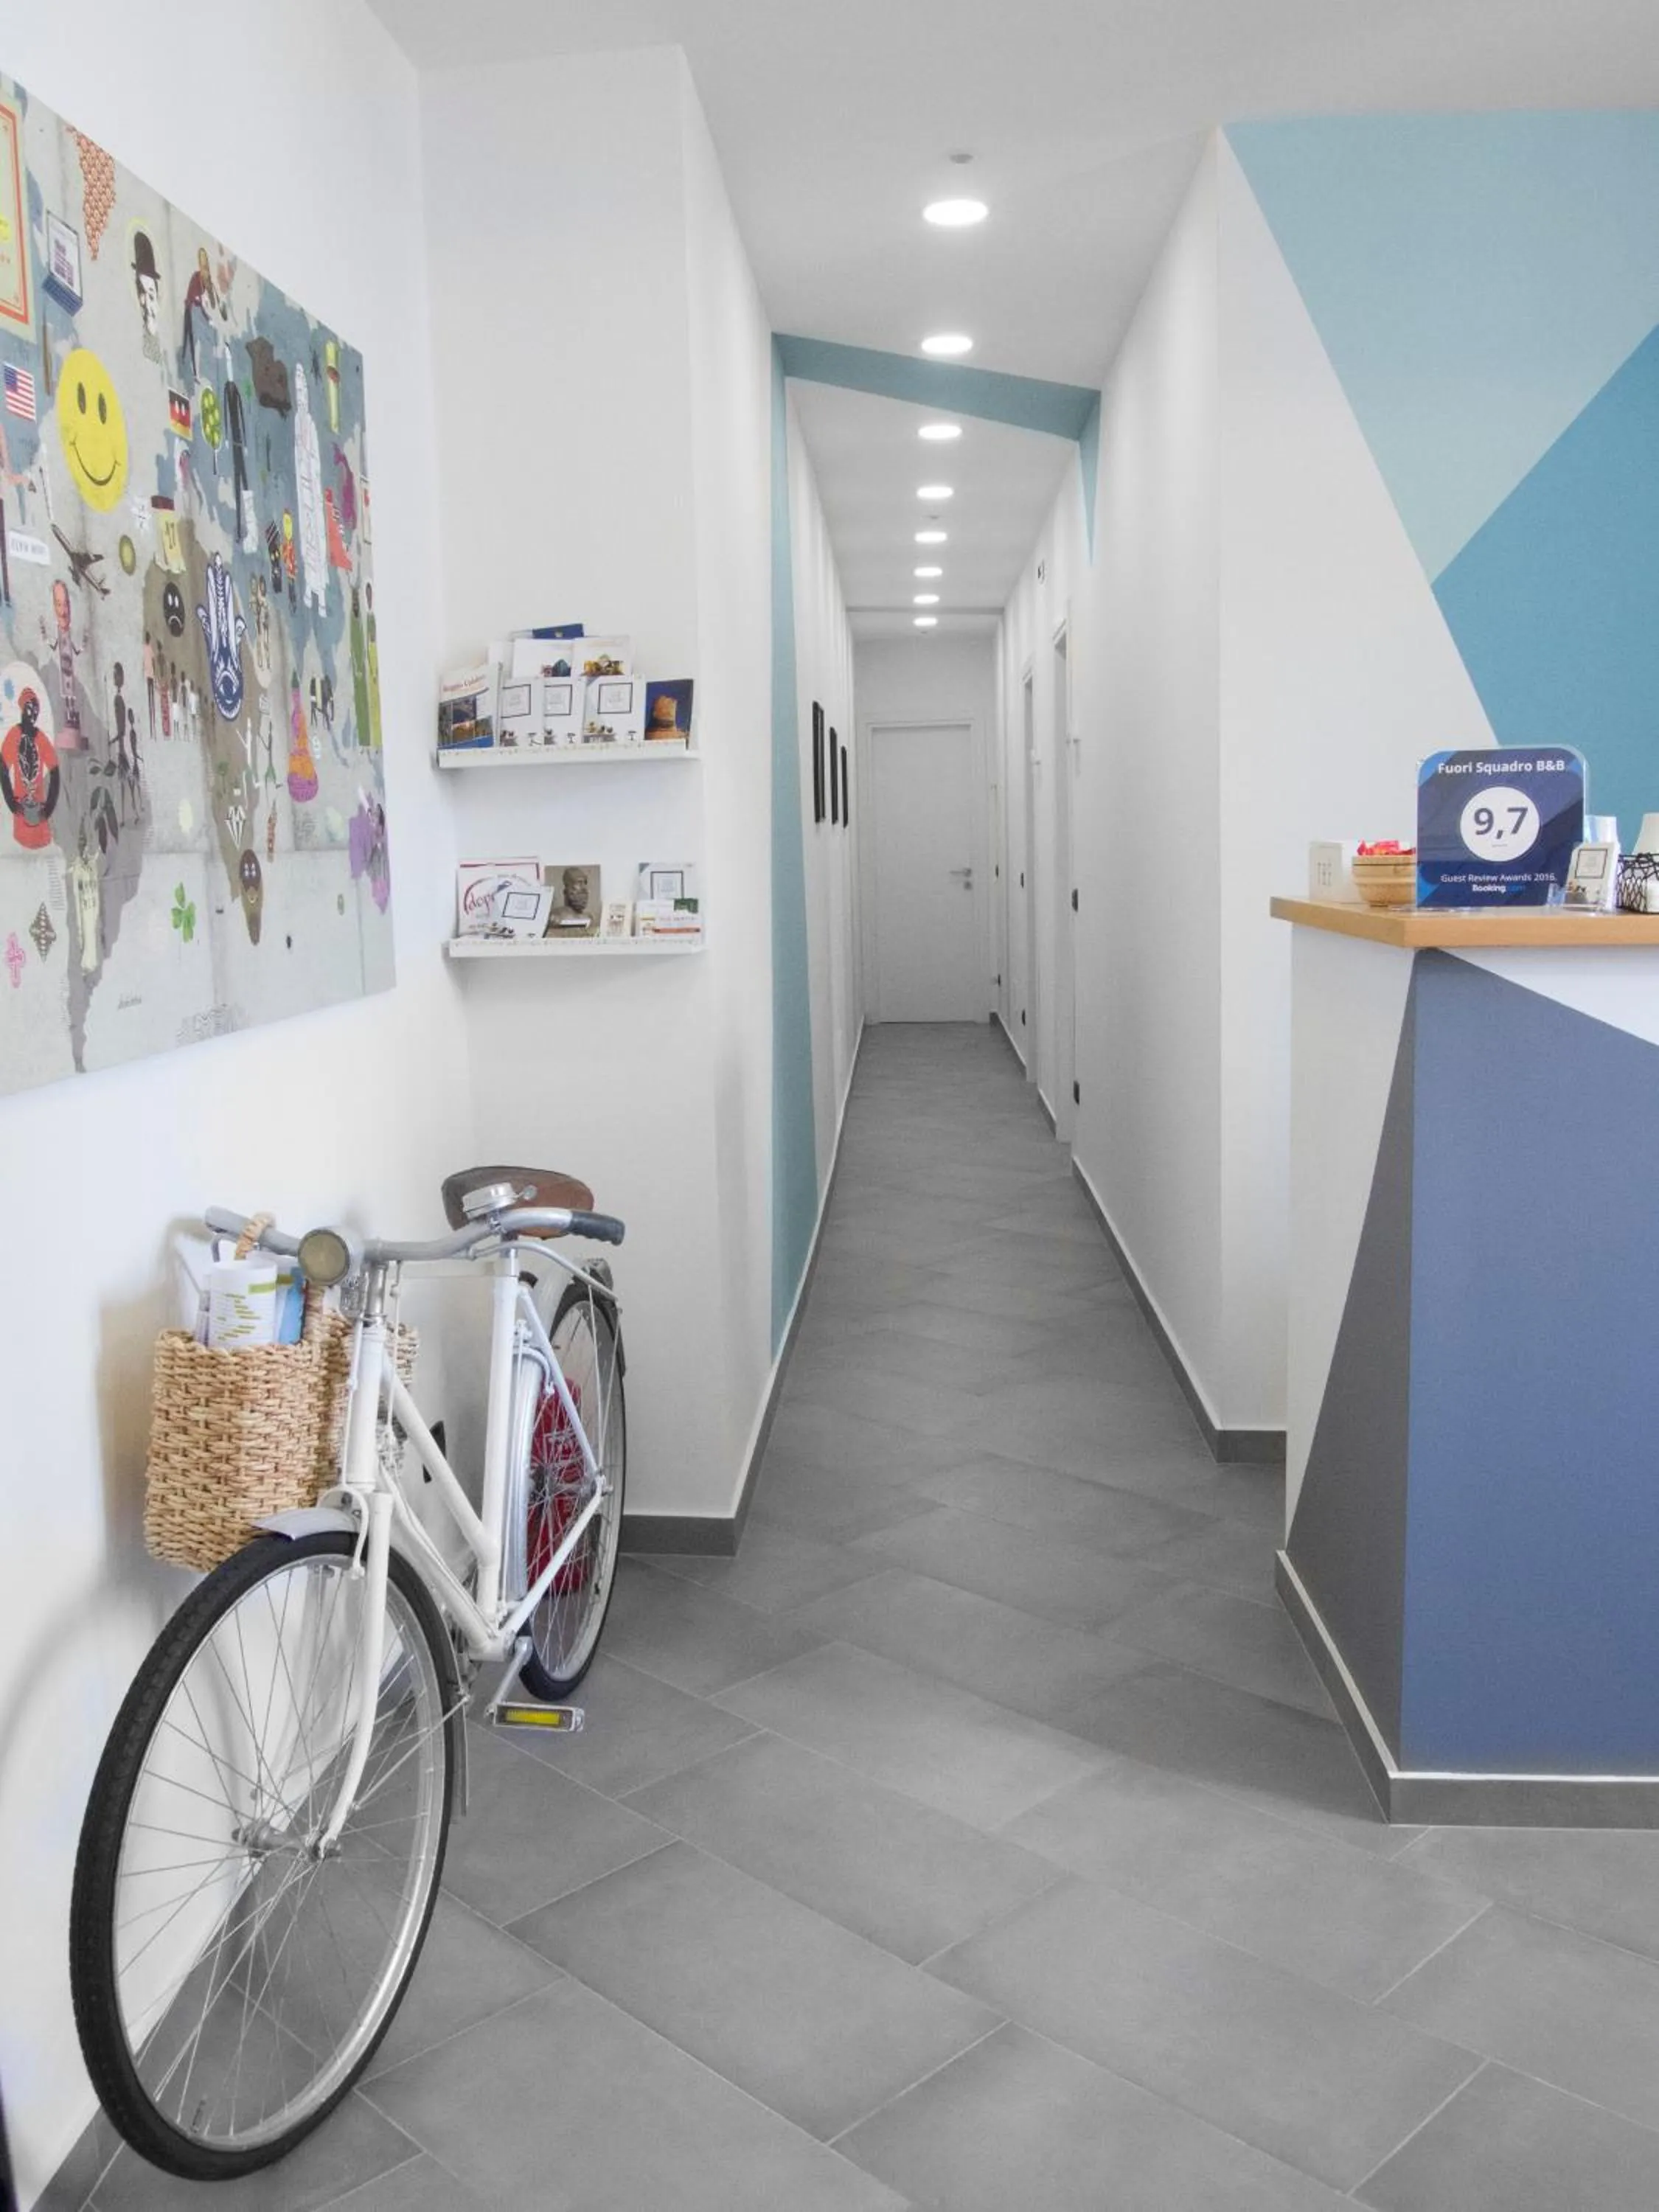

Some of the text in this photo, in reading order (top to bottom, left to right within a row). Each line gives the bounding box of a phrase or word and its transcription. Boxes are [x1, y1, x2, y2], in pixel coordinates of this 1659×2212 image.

[1439, 760, 1565, 775] Fuori Squadro B&B
[1473, 807, 1528, 840] 9,7
[1440, 874, 1467, 883] Guest
[1468, 874, 1499, 883] Review
[1500, 873, 1532, 882] Awards
